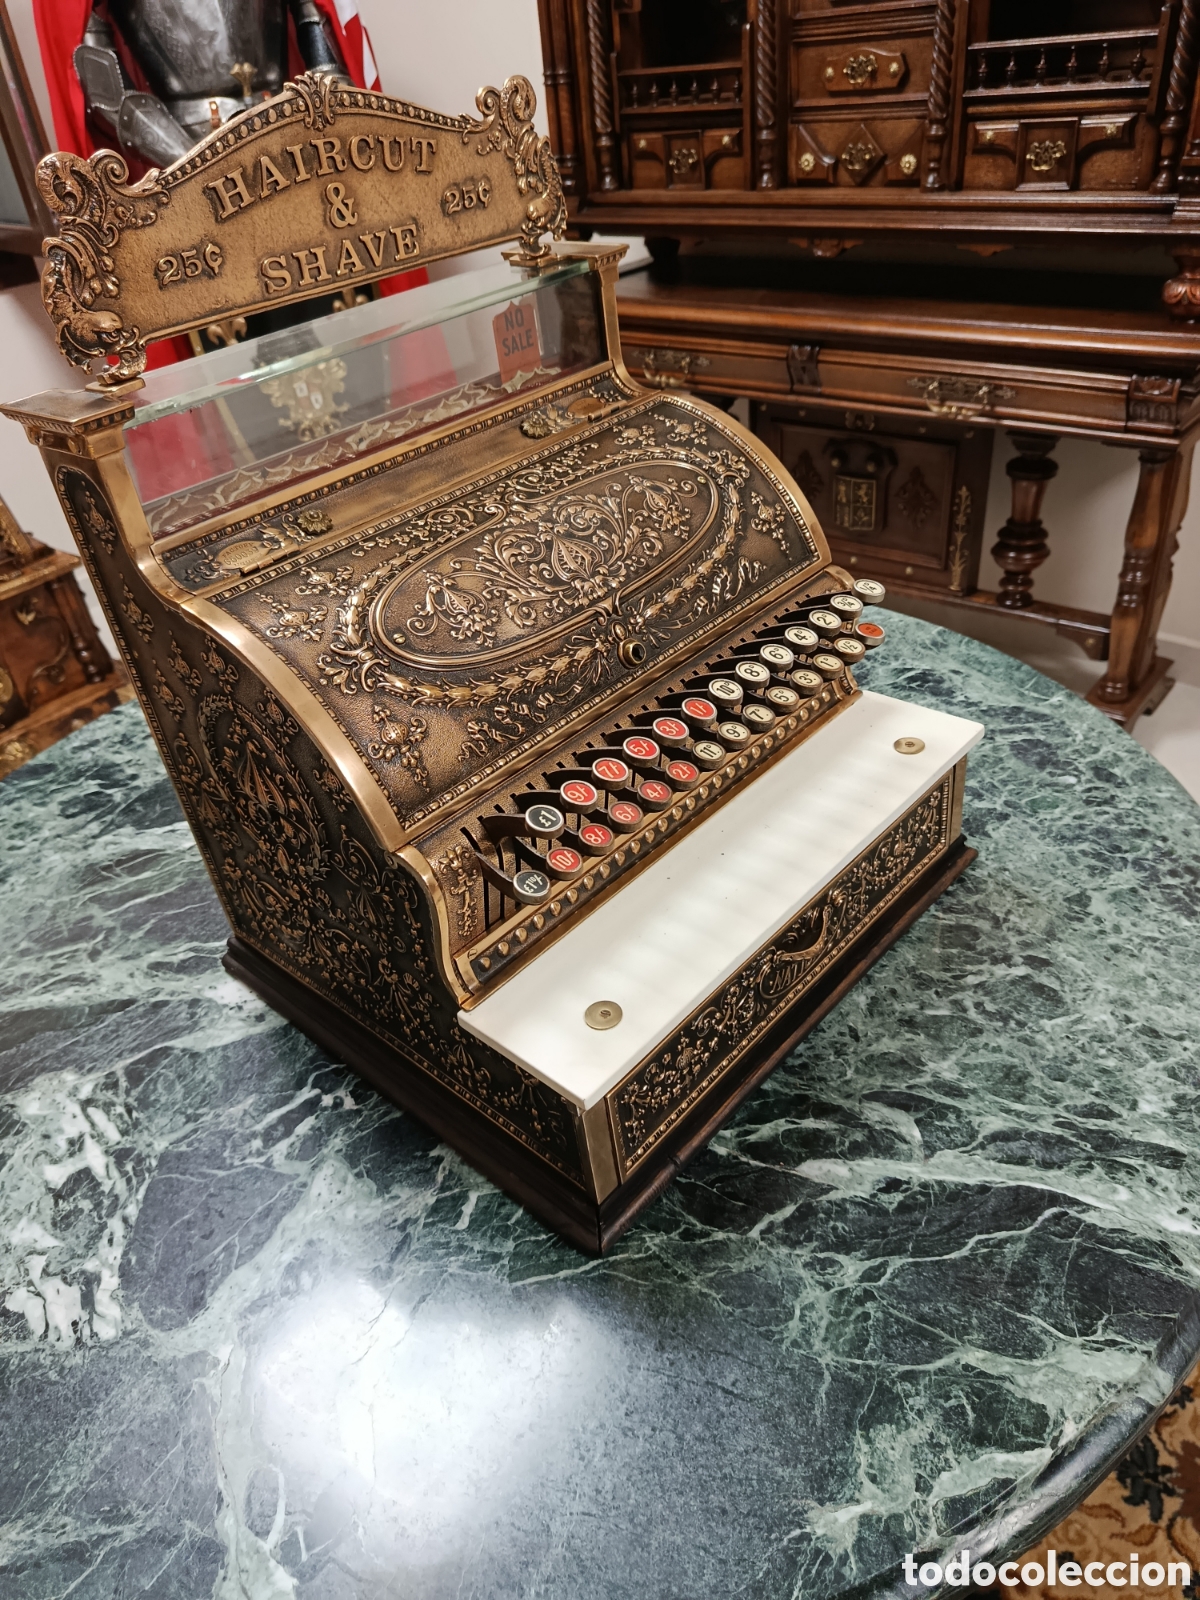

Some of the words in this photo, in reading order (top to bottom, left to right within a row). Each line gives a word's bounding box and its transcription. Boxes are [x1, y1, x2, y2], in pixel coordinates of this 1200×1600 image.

[205, 133, 437, 220] HAIRCUT
[323, 181, 359, 229] &
[445, 180, 492, 216] 25¢
[157, 241, 225, 286] 25¢
[260, 223, 421, 295] SHAVE
[503, 308, 525, 332] NO
[502, 328, 534, 357] SALE
[222, 542, 254, 558] FACTORY
[538, 810, 557, 827] £1
